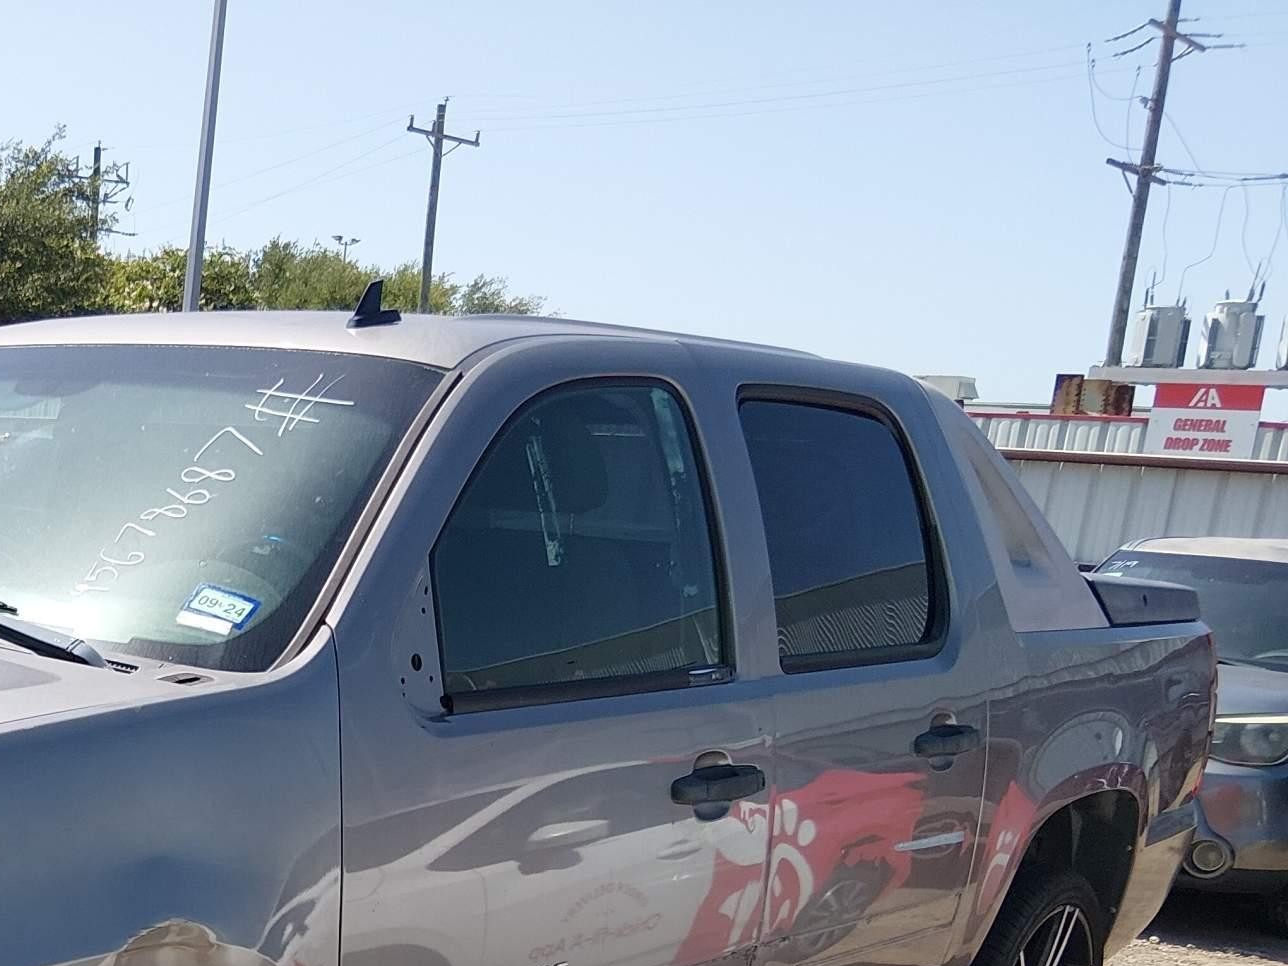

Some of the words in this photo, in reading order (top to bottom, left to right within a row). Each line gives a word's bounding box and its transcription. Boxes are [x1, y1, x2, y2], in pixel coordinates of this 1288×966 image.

[1173, 418, 1227, 433] GENERAL
[1164, 436, 1200, 451] DROP
[1199, 438, 1233, 453] ZONE
